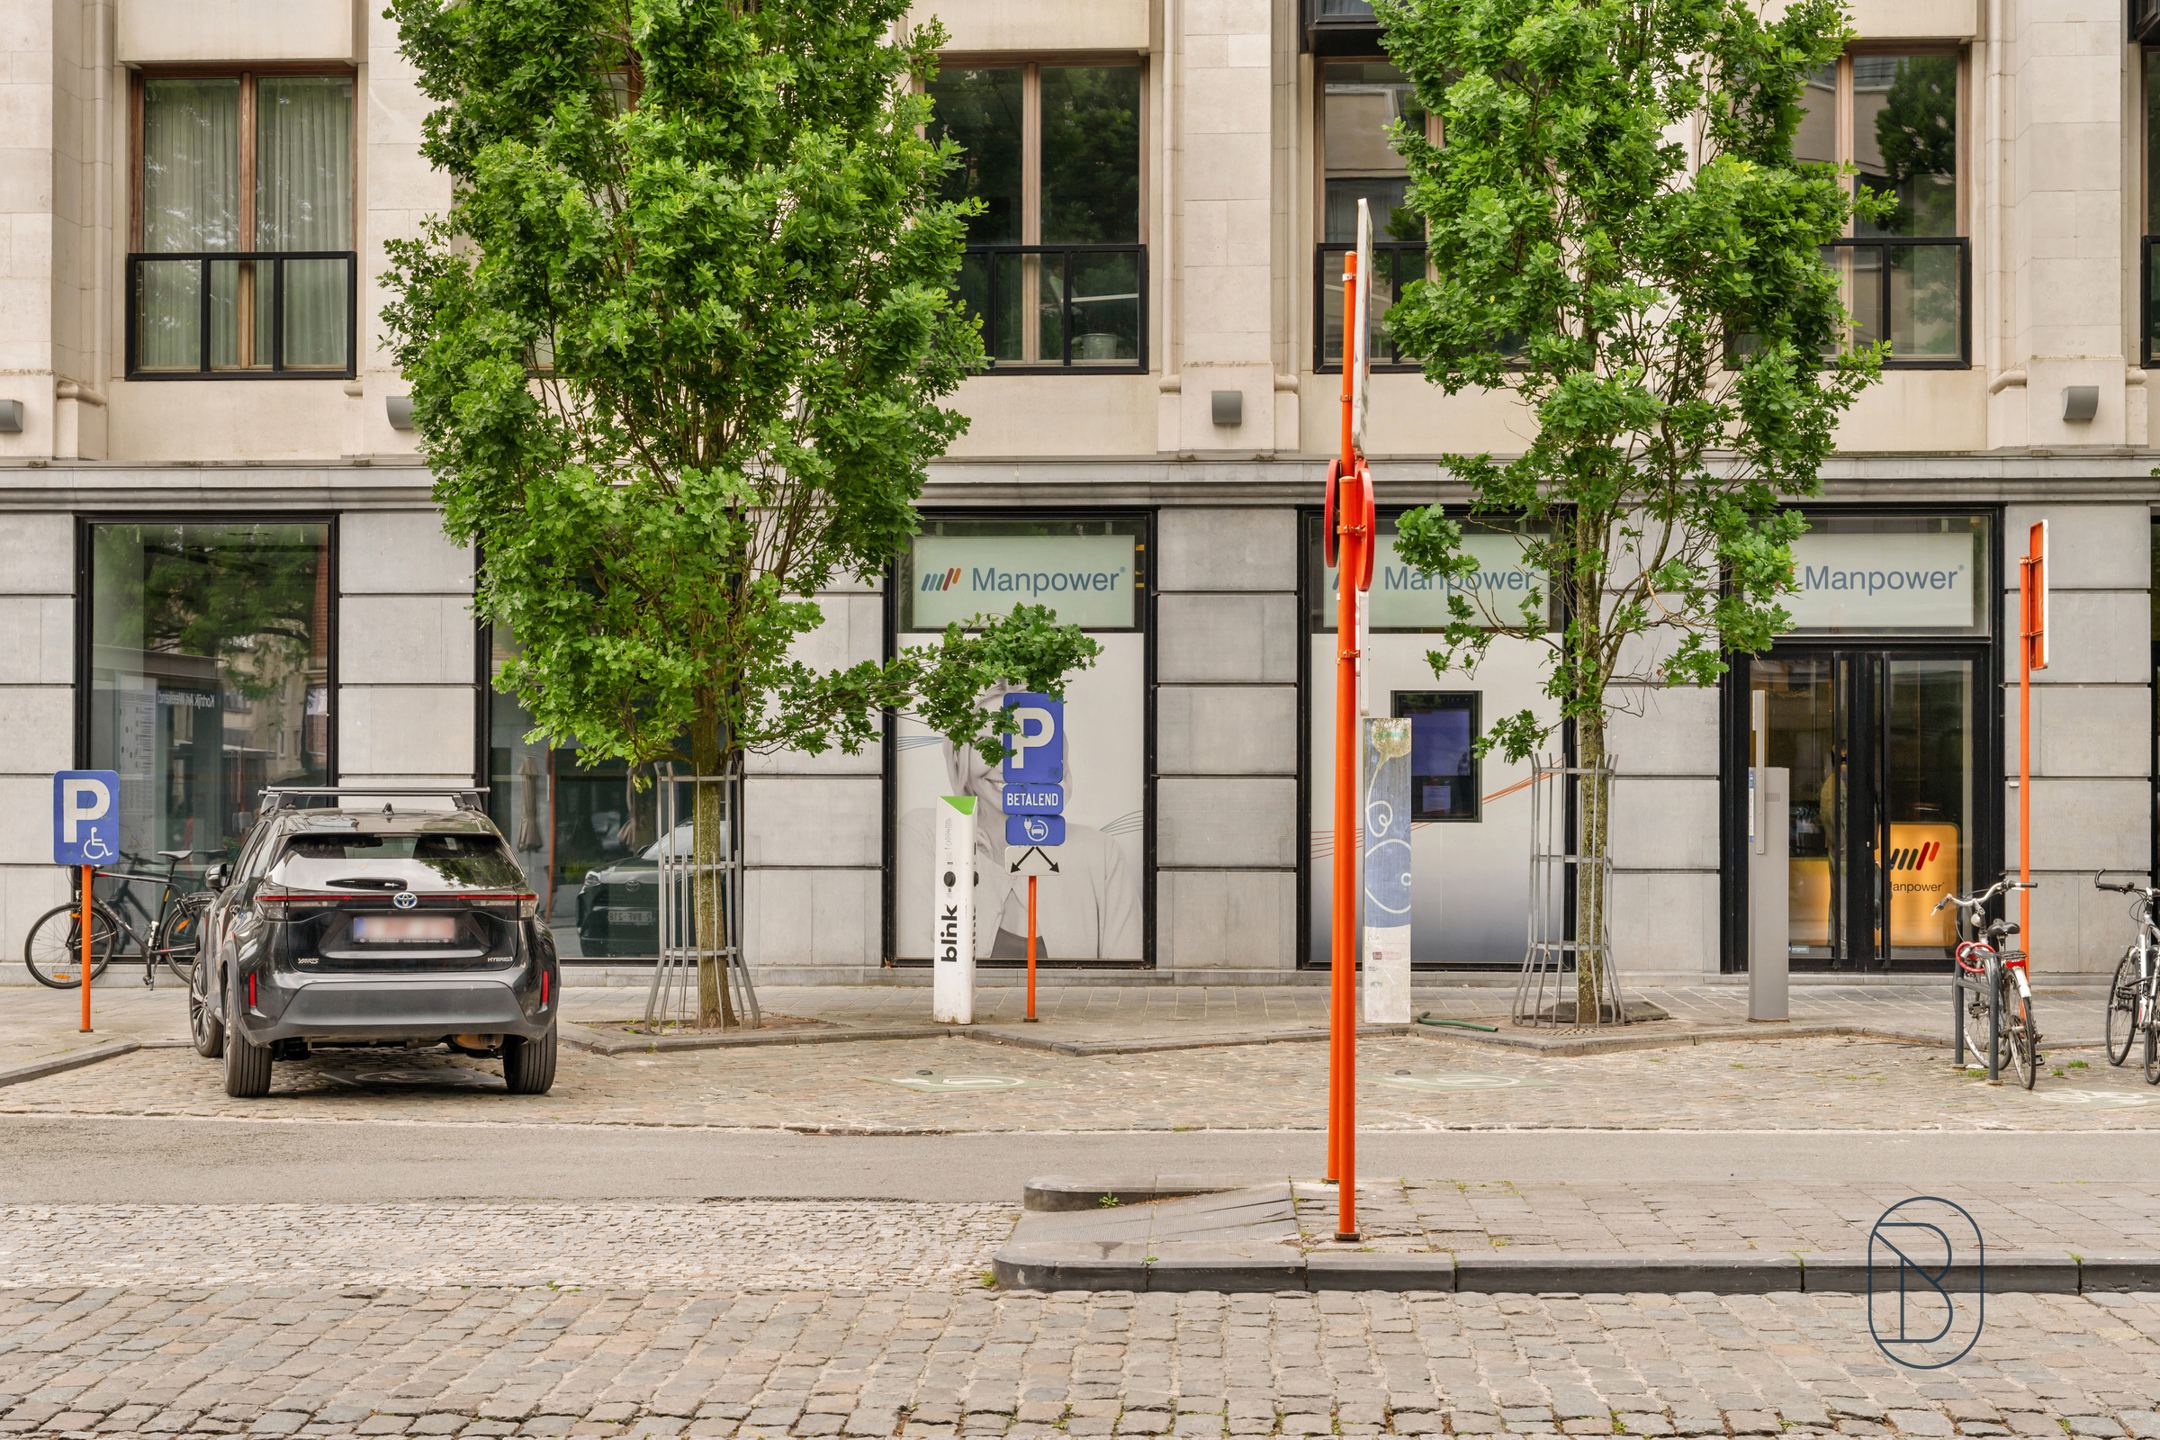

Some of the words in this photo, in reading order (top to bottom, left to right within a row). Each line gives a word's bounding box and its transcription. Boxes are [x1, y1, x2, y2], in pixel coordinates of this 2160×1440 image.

[1011, 707, 1055, 769] P
[63, 779, 110, 843] P
[1006, 793, 1059, 806] BETALEND
[1890, 882, 1943, 893] anpower
[940, 904, 958, 962] blink
